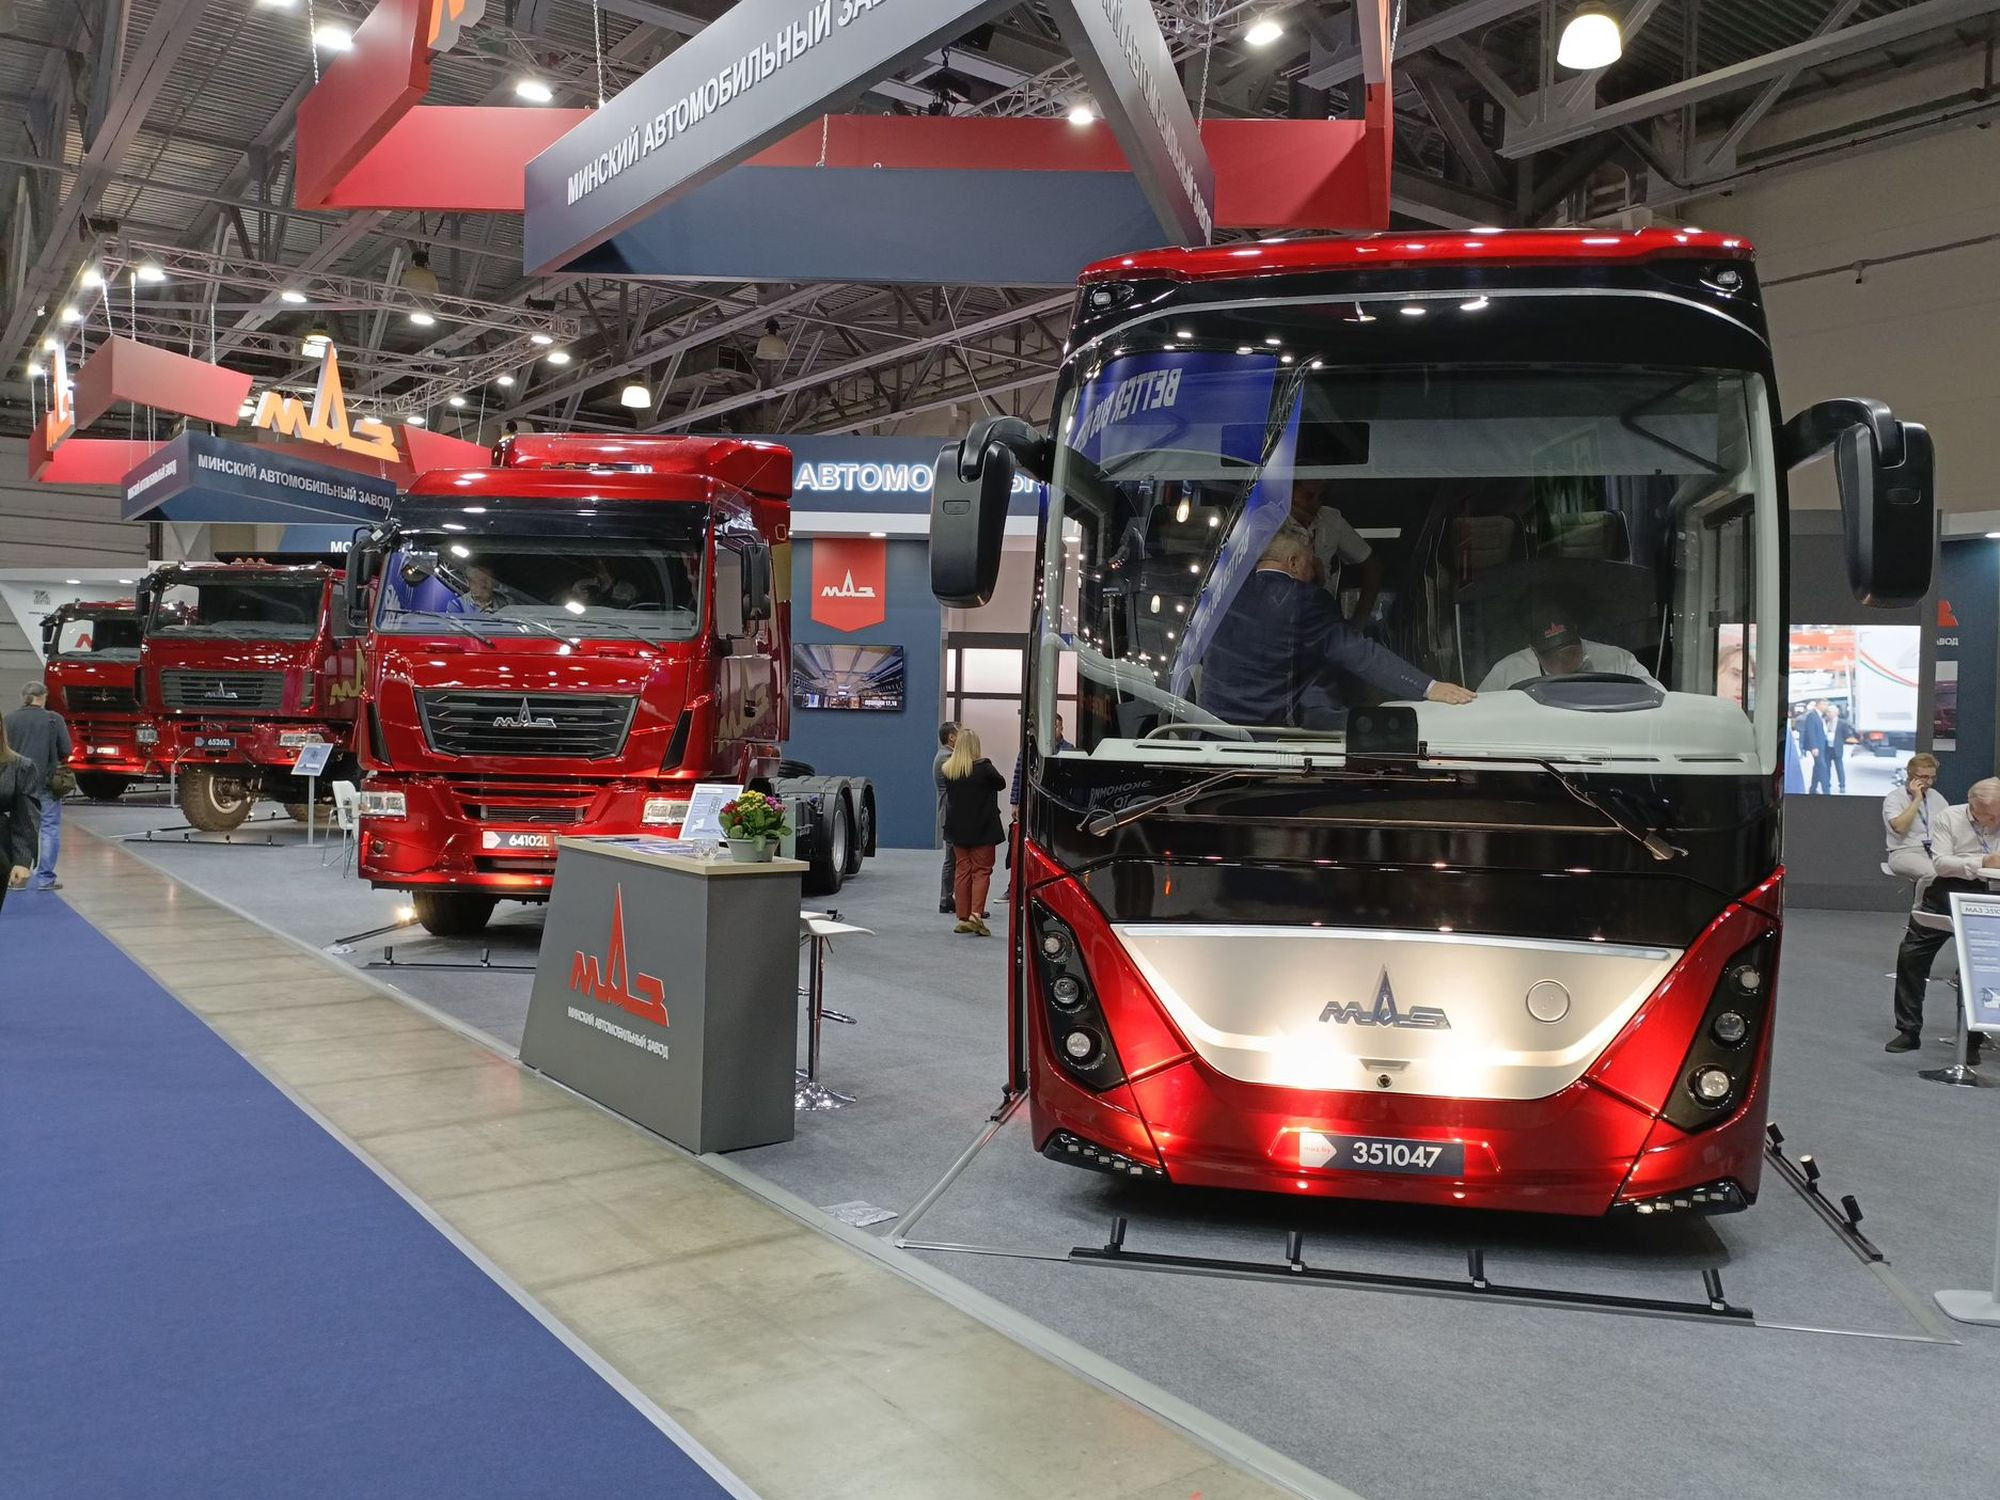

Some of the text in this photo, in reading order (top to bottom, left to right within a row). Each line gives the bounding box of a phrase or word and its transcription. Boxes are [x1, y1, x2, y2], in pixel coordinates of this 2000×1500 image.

[567, 127, 640, 206] МИНСКИЙ
[643, 0, 832, 158] АВТОМОБИЛЬНЫЙ
[198, 453, 392, 511] МИНСКИЙ АВТОМОБИЛЬНЫЙ ЗАВОД
[508, 834, 550, 847] 64102L
[567, 1005, 669, 1061] МИНСКИЙ АВТОМОБИЛЬНЫЙ ЗАВОД
[1352, 1141, 1442, 1169] 351047
